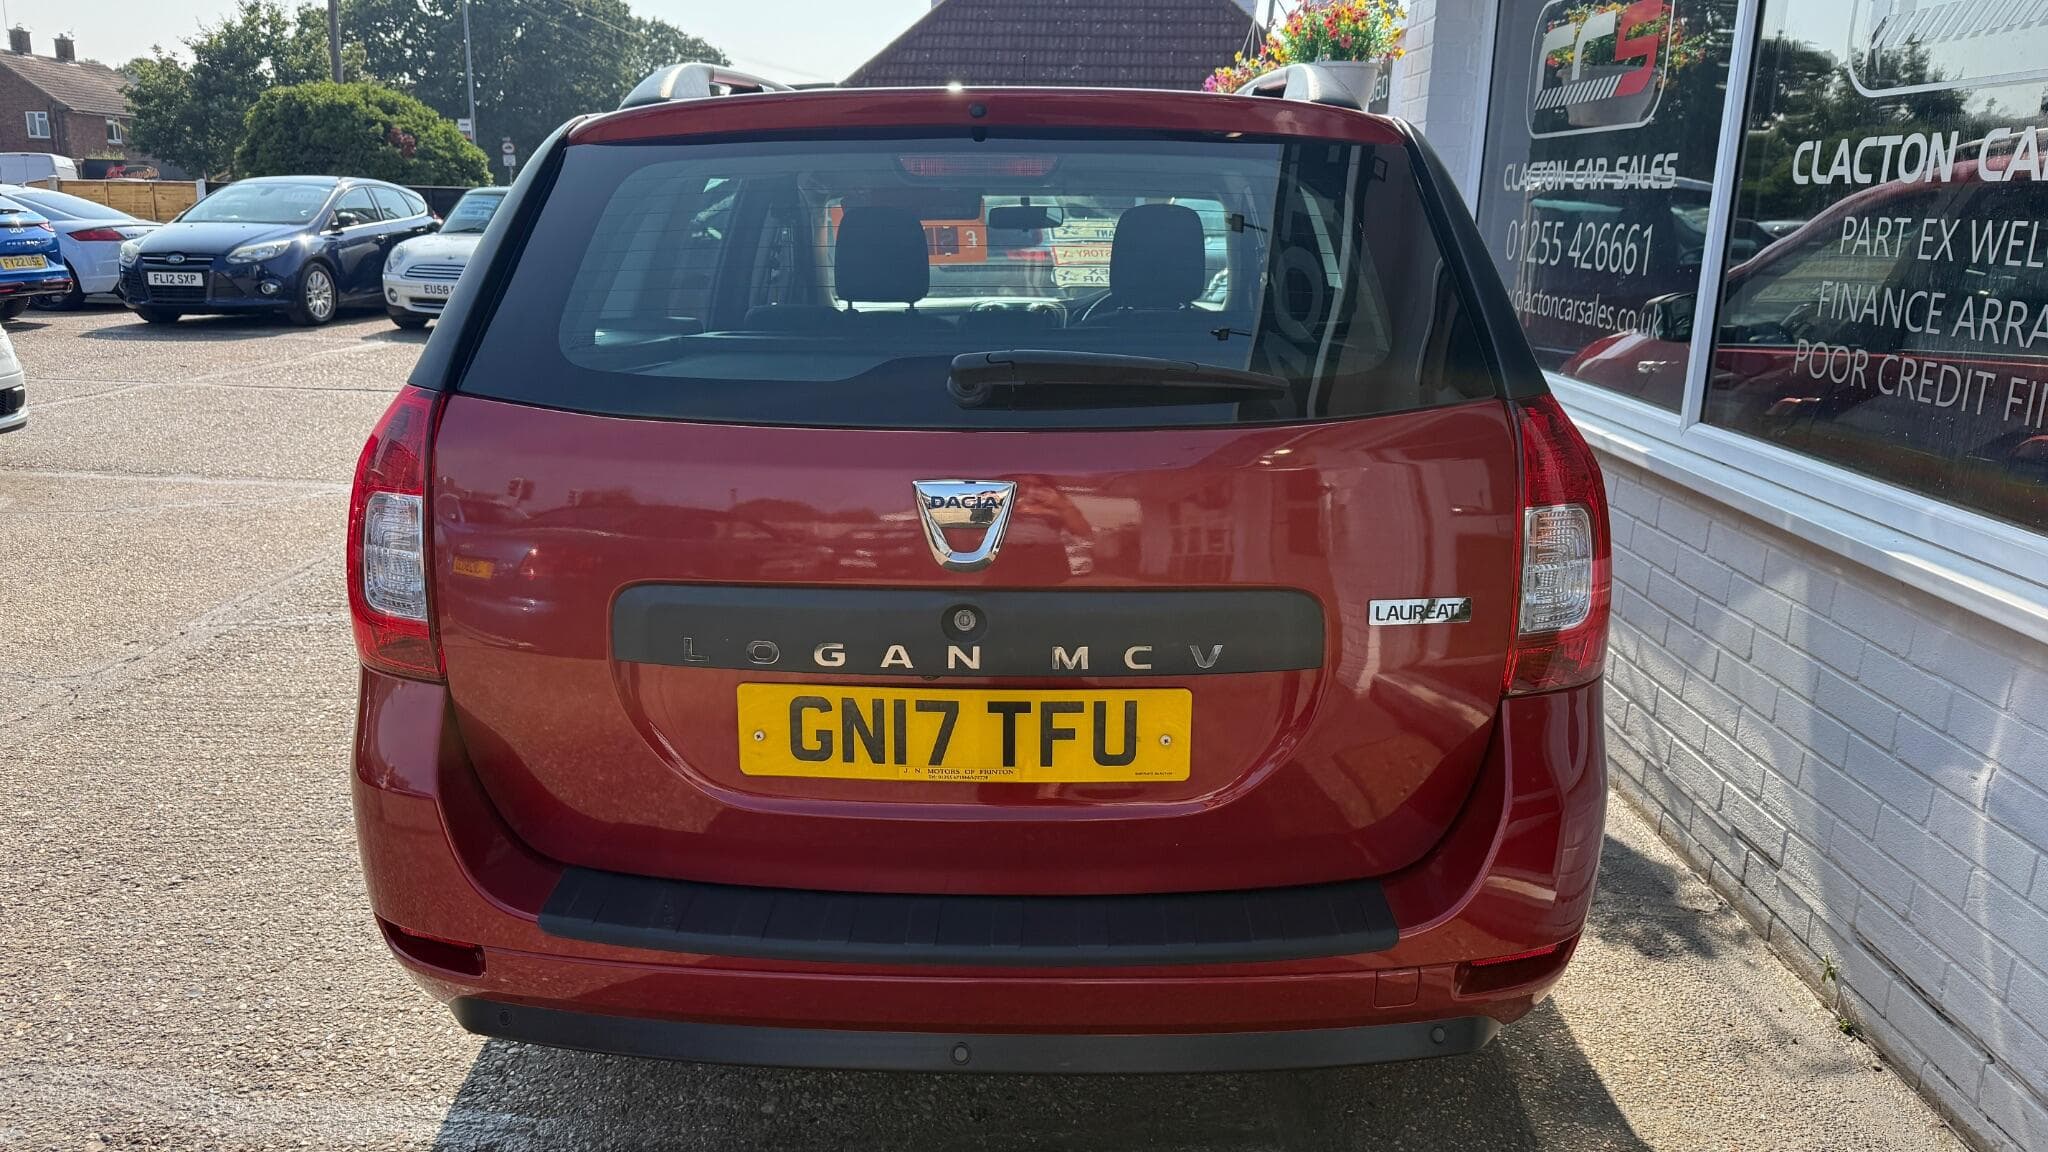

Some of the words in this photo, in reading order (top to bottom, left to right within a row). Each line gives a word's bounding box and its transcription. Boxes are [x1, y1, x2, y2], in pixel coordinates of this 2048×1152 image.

[1369, 75, 1388, 103] 60
[1504, 160, 1567, 191] CLACTON
[1571, 157, 1608, 190] CAR
[1613, 153, 1678, 190] SALES
[1792, 130, 1959, 185] CLACTON
[1977, 126, 2048, 182] CA
[1506, 219, 1564, 266] 01255
[1567, 221, 1653, 276] 426661
[1840, 216, 1912, 258] PART
[1917, 218, 1960, 262] EX
[1971, 219, 2048, 268] WEL
[153, 273, 175, 284] FL12
[177, 274, 197, 285] SXP
[424, 284, 449, 295] EU58
[1817, 280, 1946, 335] FINANCE
[1793, 338, 1869, 390] POOR
[1878, 353, 1996, 415] CREDIT
[931, 496, 998, 509] DACIA
[1375, 602, 1470, 621] LAUREAT
[683, 637, 981, 669] LOGAN
[1052, 644, 1223, 669] MCV
[789, 695, 960, 766] GN17
[987, 700, 1137, 767] TFU
